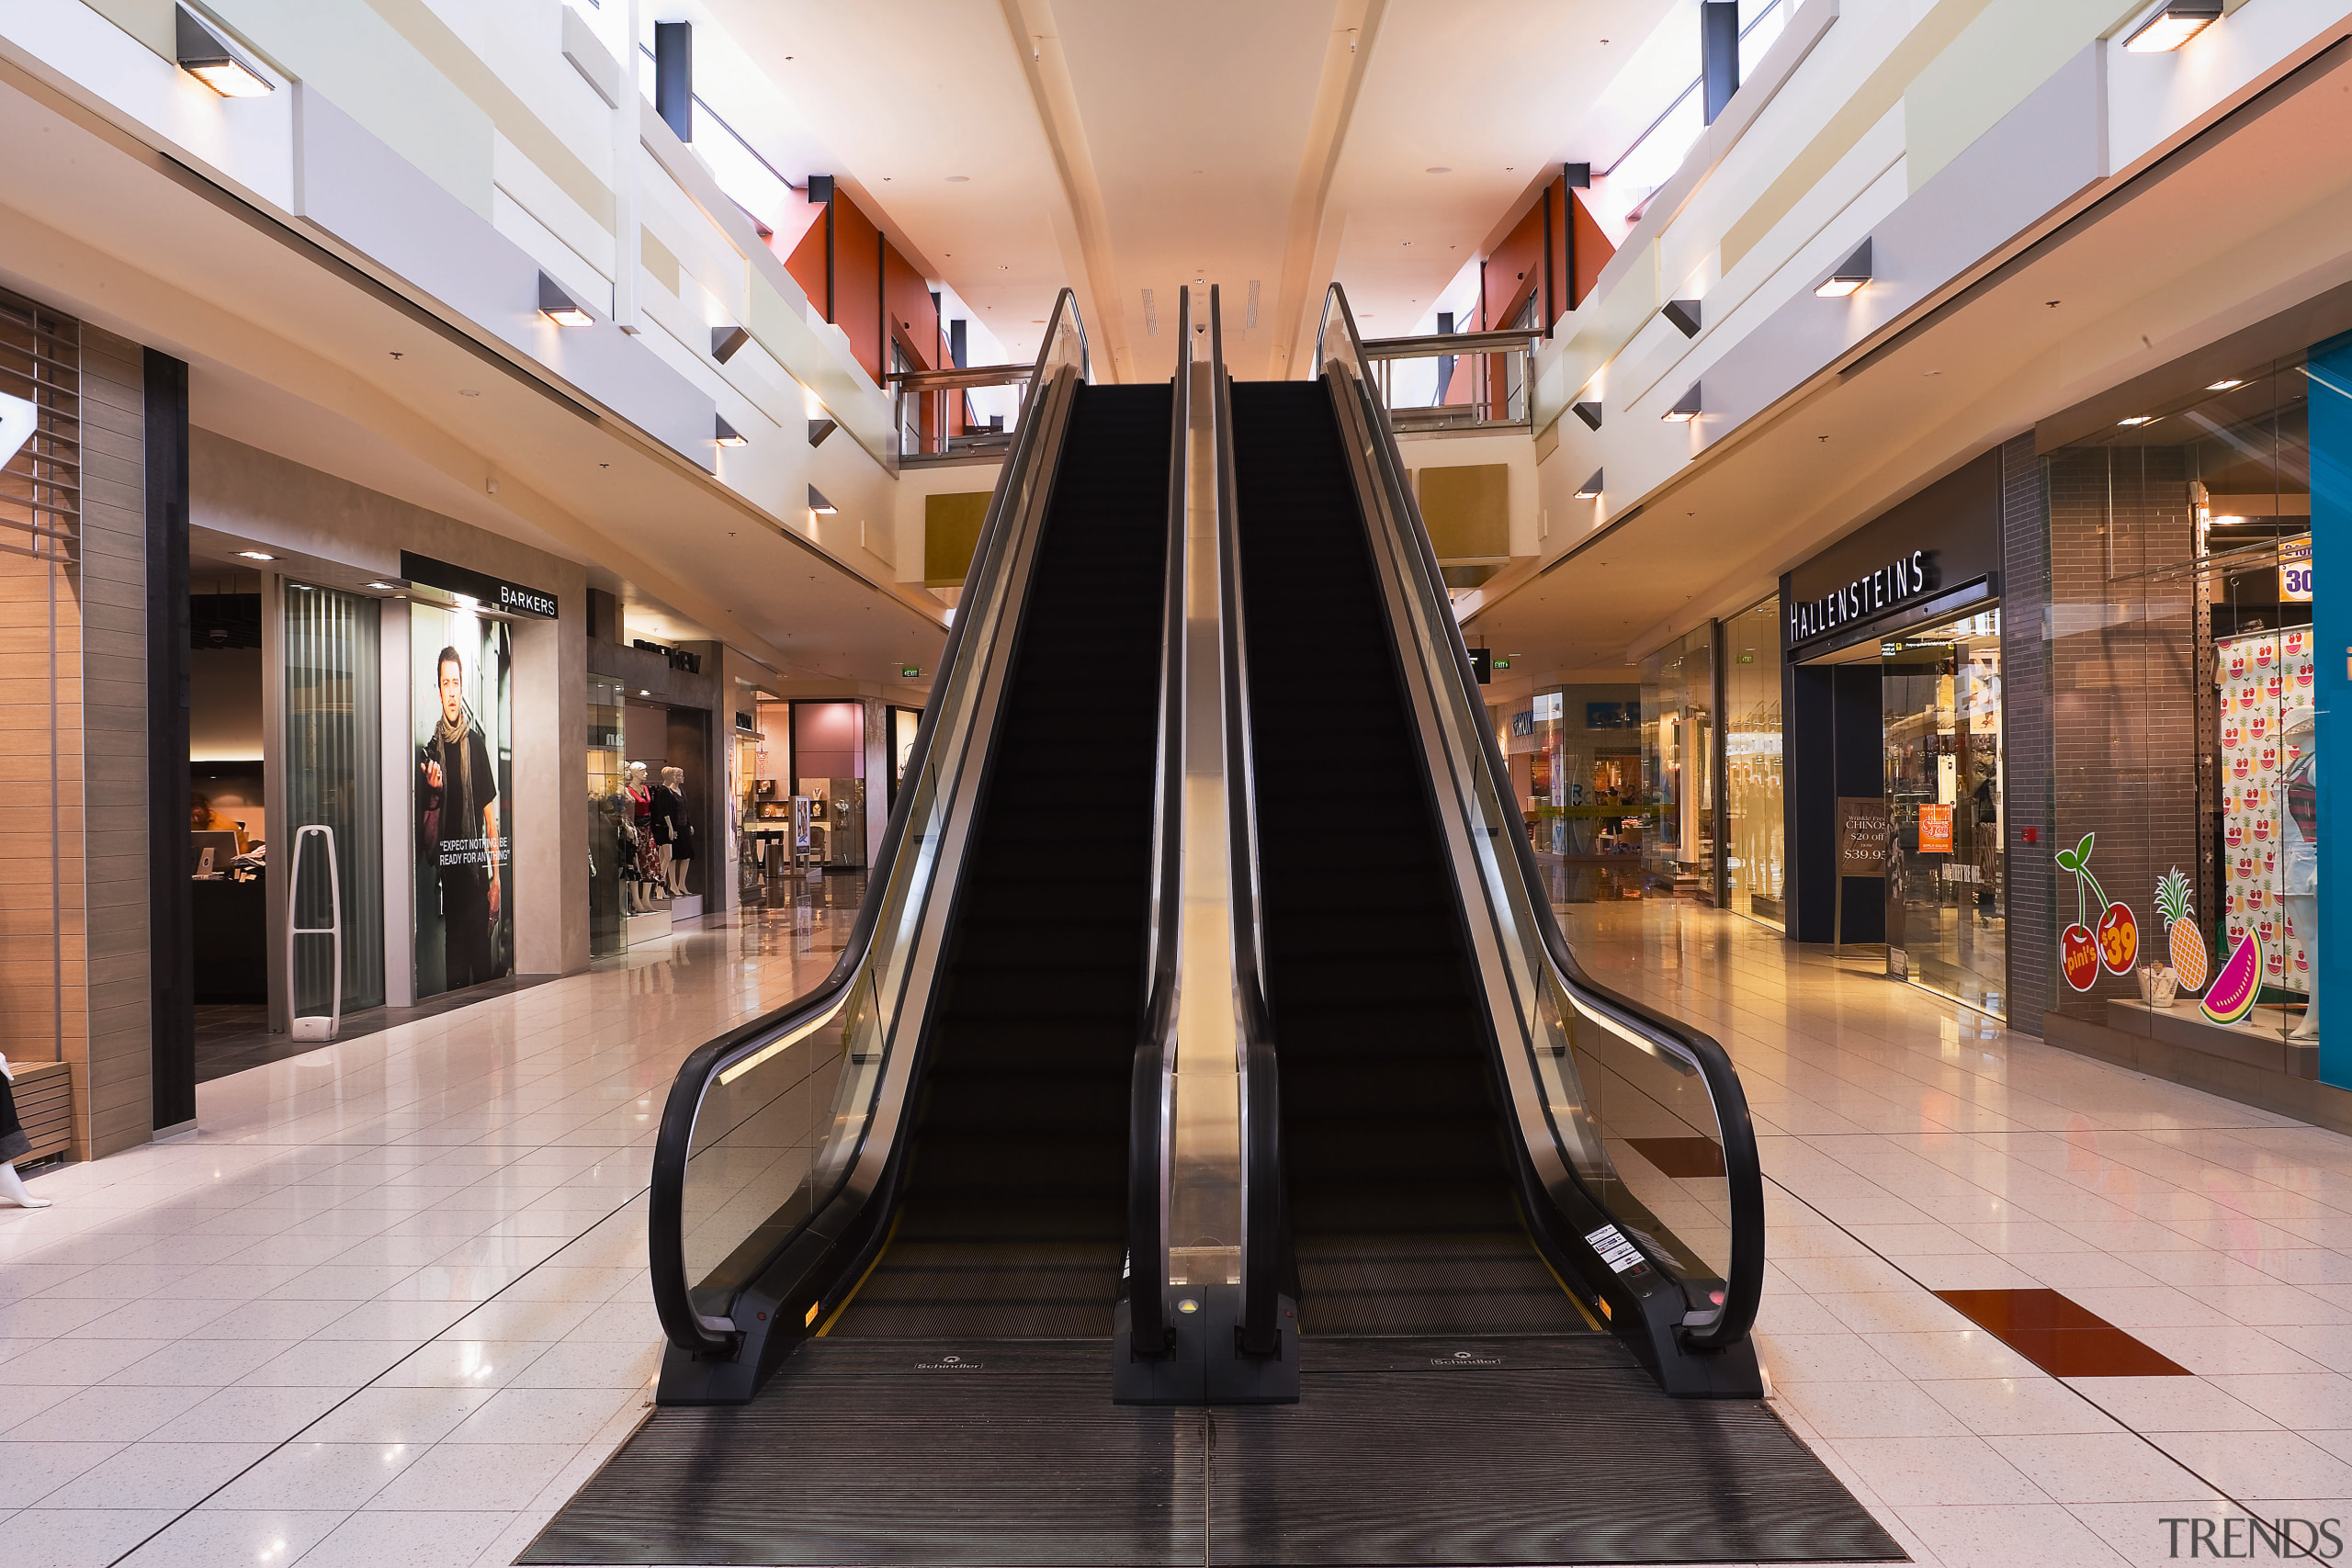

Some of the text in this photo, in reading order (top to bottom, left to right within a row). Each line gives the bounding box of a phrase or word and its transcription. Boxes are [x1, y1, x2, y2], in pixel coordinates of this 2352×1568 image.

[501, 586, 555, 615] BARKERS
[1791, 550, 1923, 642] HALLENSTEINS
[500, 837, 507, 847] BE
[1850, 832, 1884, 840] $20 off
[440, 853, 462, 865] READY
[463, 852, 477, 863] FOR
[2067, 922, 2136, 976] pini's $39
